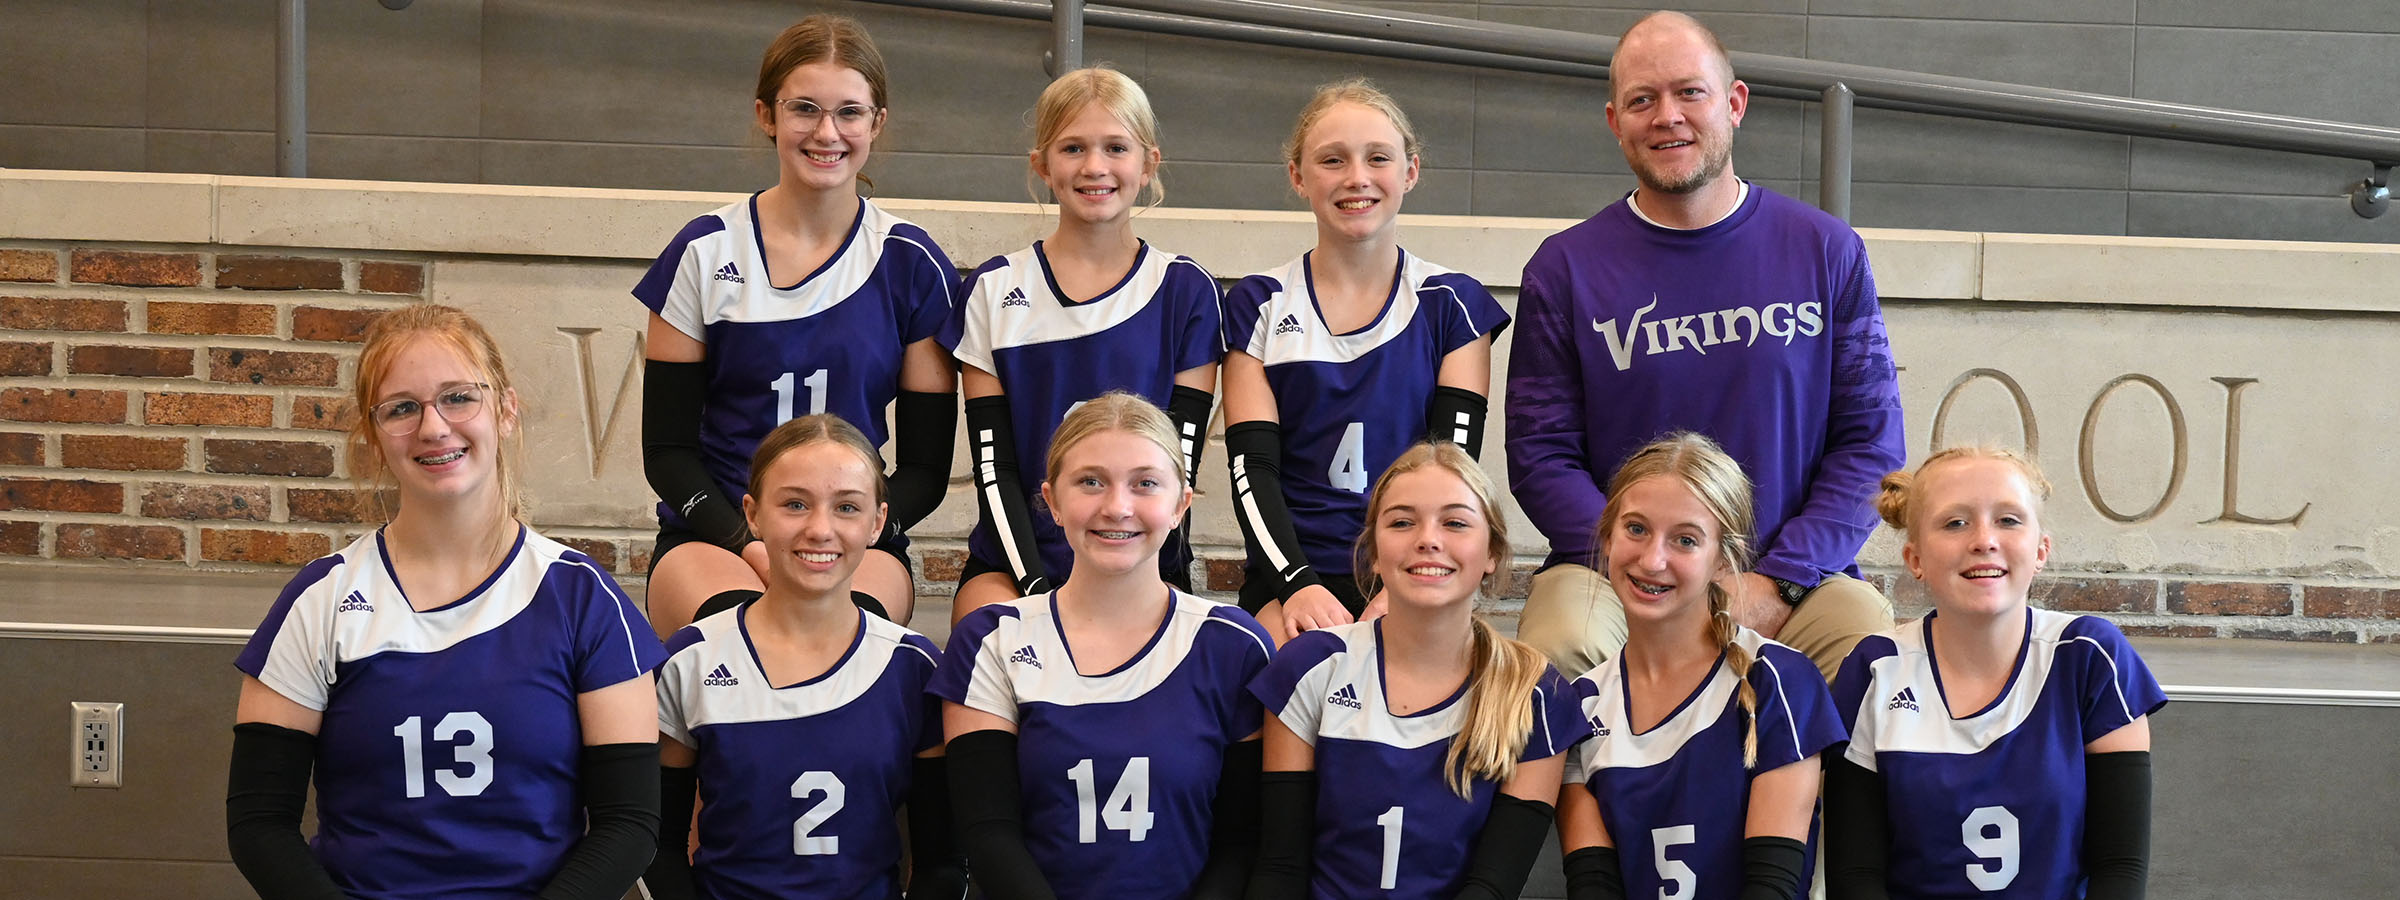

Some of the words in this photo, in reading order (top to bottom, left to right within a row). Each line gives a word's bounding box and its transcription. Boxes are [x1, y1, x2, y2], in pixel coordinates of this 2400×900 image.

[713, 272, 745, 284] adidas
[771, 369, 828, 428] 11
[1328, 422, 1368, 494] 4
[339, 602, 374, 613] adidas
[704, 678, 739, 687] adidas
[1010, 654, 1043, 670] adidas
[1328, 696, 1362, 710] adidas
[1888, 700, 1920, 713] adidas
[394, 711, 494, 798] 13
[790, 771, 846, 856] 2
[1067, 757, 1155, 844] 14
[1377, 806, 1404, 890] 1
[1651, 824, 1697, 900] 5
[1961, 805, 2020, 892] 9
